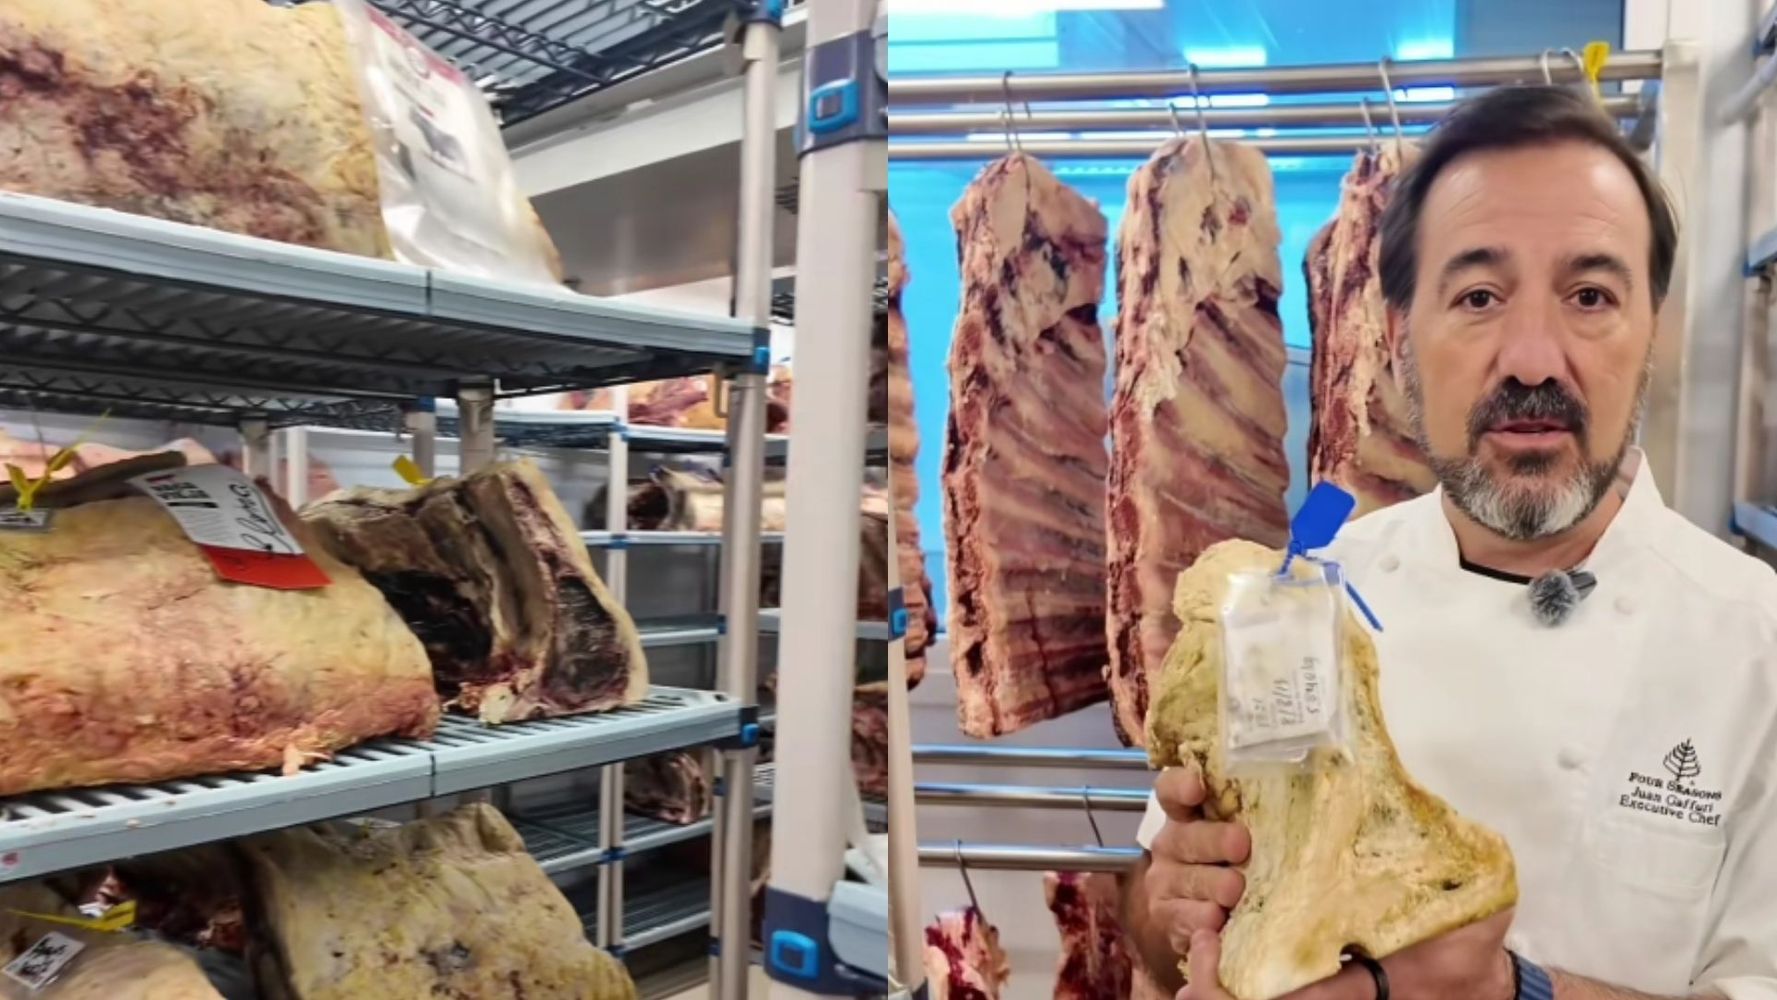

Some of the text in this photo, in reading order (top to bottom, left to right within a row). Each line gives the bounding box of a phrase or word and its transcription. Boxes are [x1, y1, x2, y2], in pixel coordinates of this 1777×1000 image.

[1628, 771, 1722, 801] FOUR SEASONS
[1630, 786, 1662, 803] Juan
[1619, 794, 1721, 827] Executive Chef
